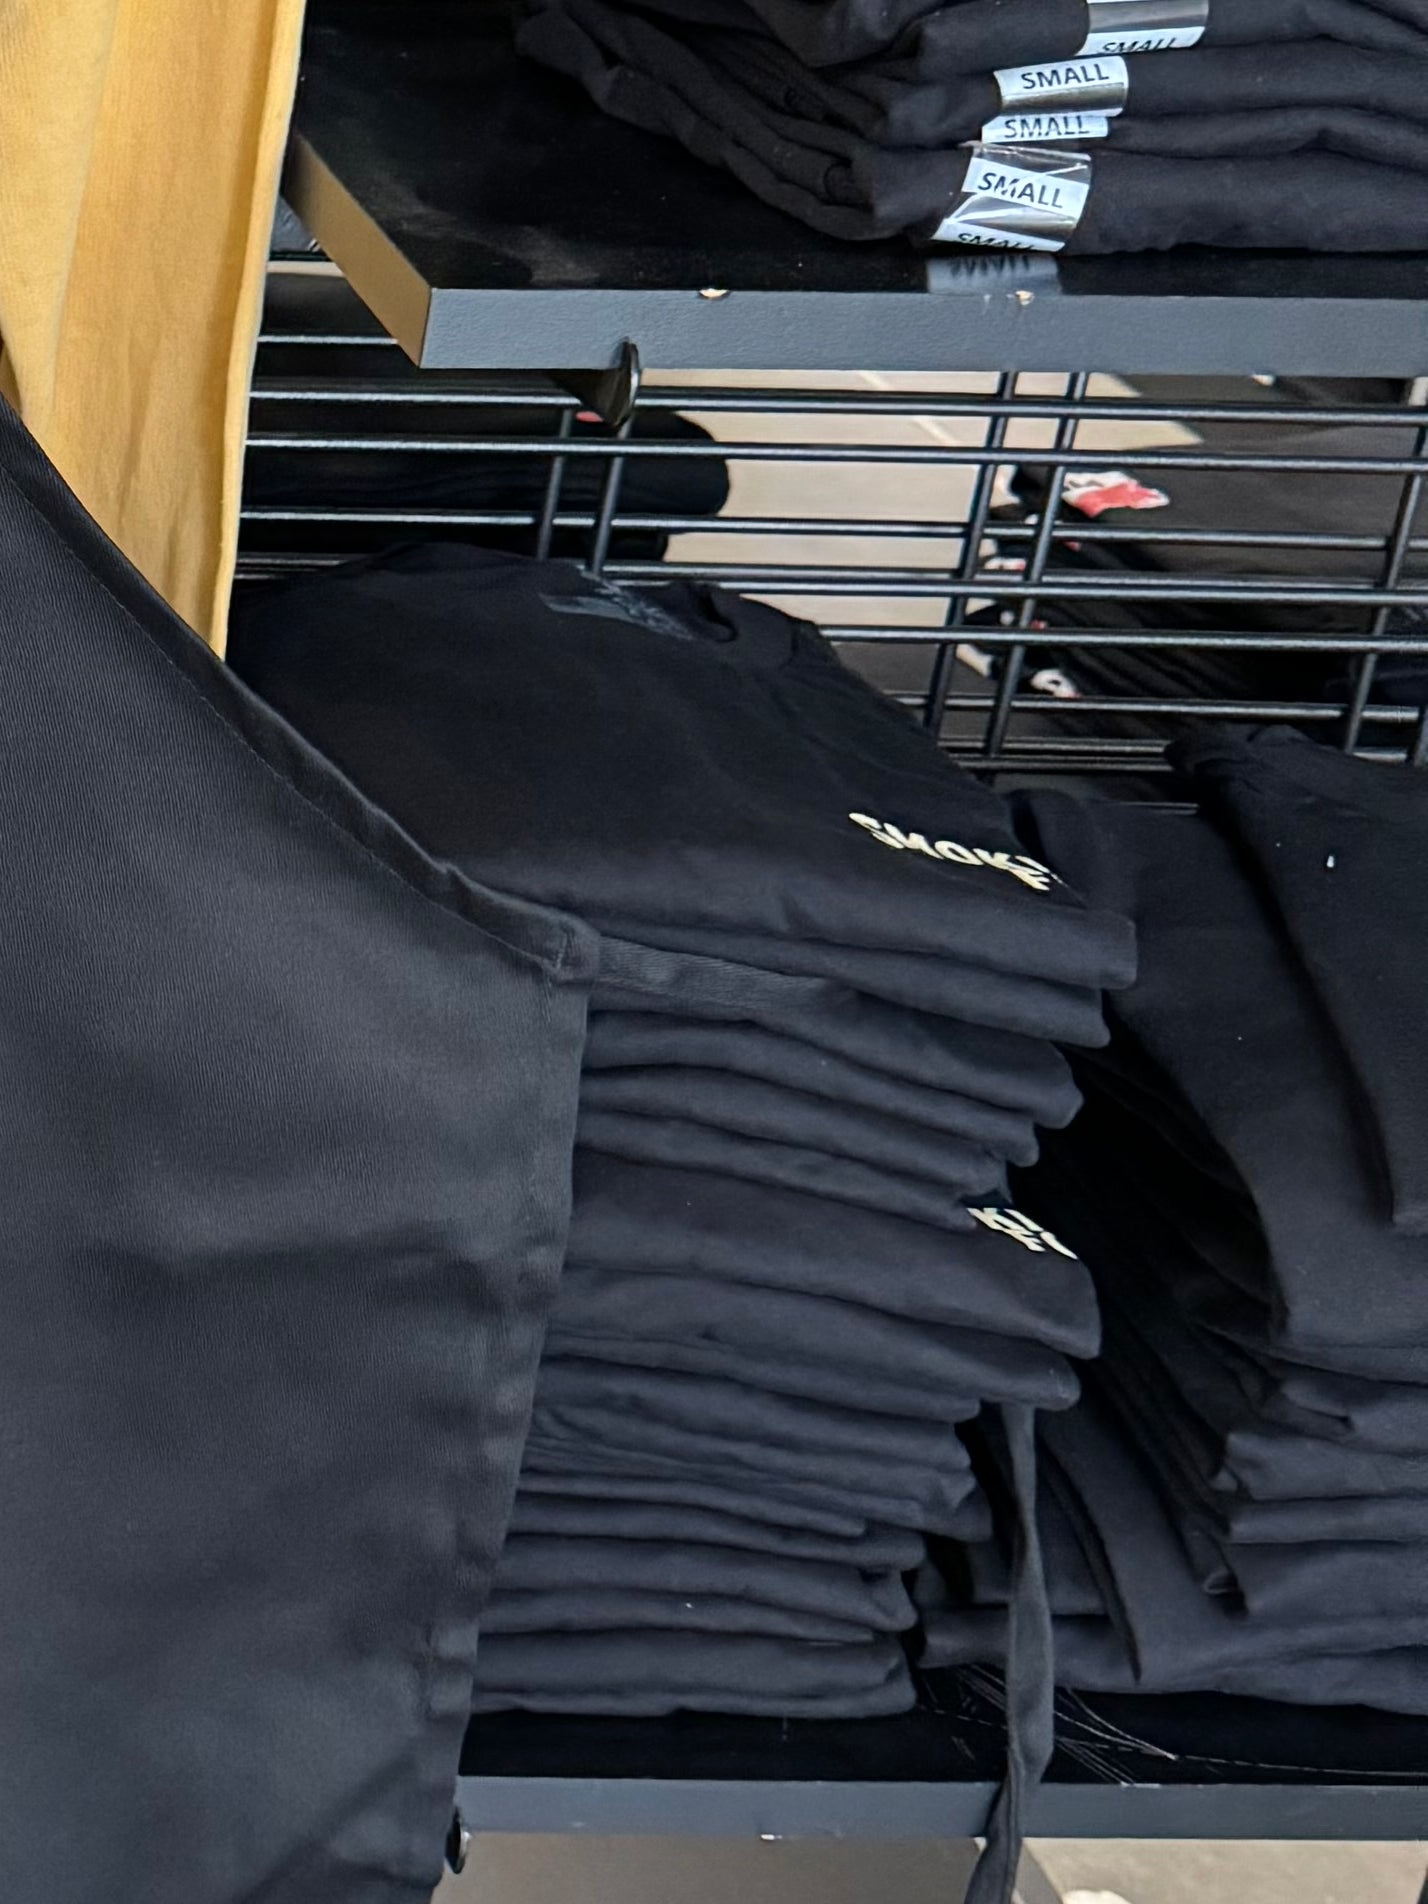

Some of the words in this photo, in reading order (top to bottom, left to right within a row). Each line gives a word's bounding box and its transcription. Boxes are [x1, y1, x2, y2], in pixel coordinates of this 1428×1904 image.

[1020, 63, 1110, 90] SMALL
[1003, 115, 1092, 139] SMALL
[976, 172, 1064, 210] SMALL
